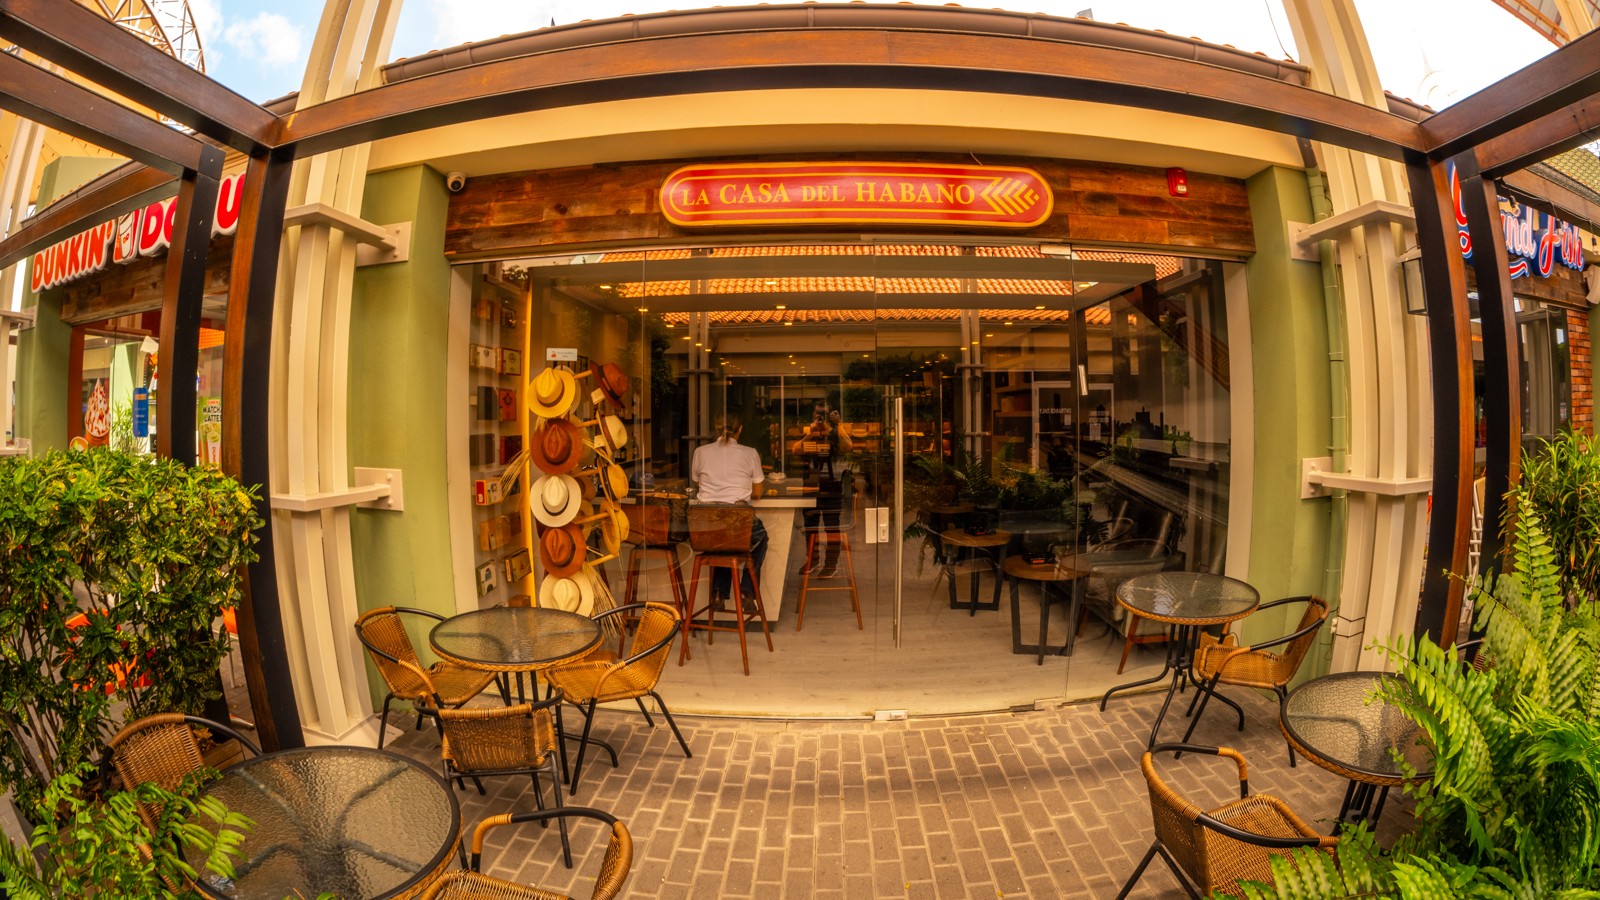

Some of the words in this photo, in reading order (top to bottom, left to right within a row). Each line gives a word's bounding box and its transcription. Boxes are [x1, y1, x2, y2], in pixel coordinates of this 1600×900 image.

[683, 189, 710, 206] LA
[719, 182, 791, 205] CASA
[802, 185, 846, 202] DEL
[855, 182, 975, 205] HABANO
